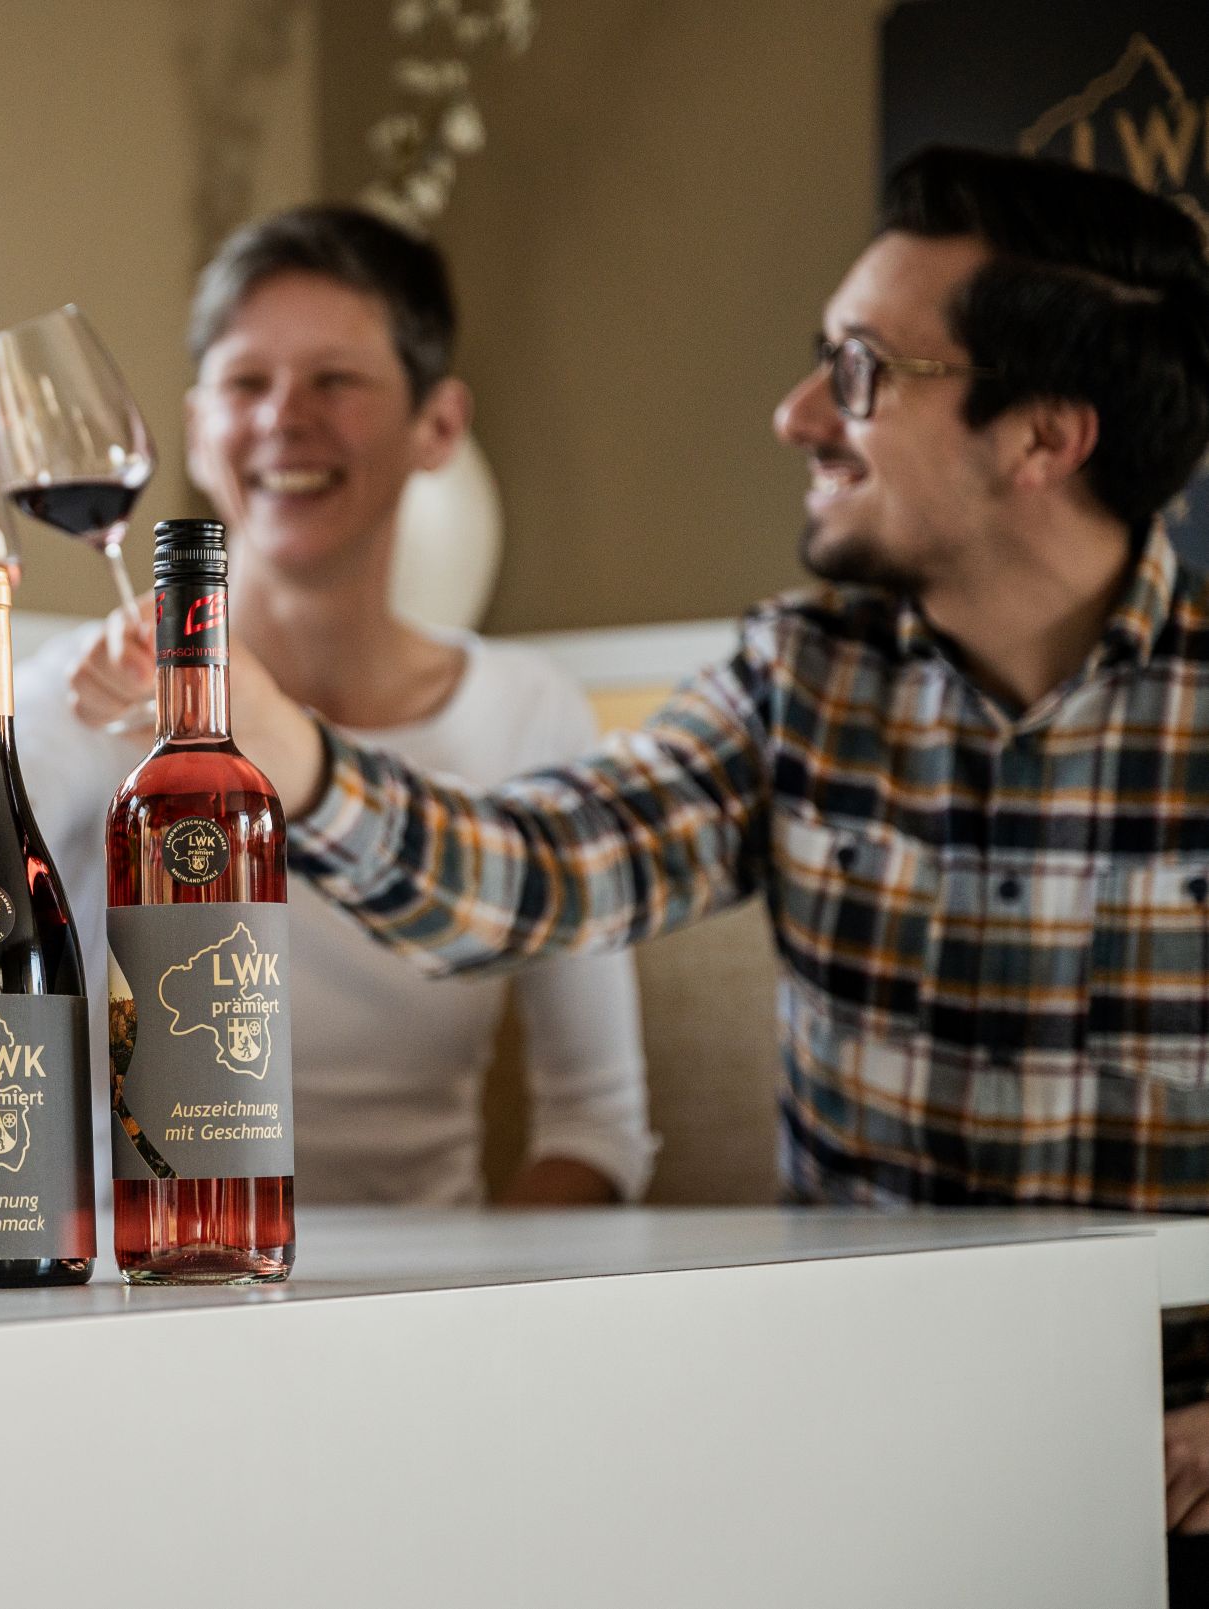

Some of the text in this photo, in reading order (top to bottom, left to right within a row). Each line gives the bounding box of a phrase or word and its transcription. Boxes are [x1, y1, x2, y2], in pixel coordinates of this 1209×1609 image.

[189, 835, 215, 847] LWK
[170, 867, 219, 884] RHEINLAND-PFALZ
[213, 953, 281, 987] LWK
[212, 997, 280, 1018] prämiert
[171, 1100, 279, 1119] Auszeichnung
[165, 1122, 283, 1141] mit Geschmack
